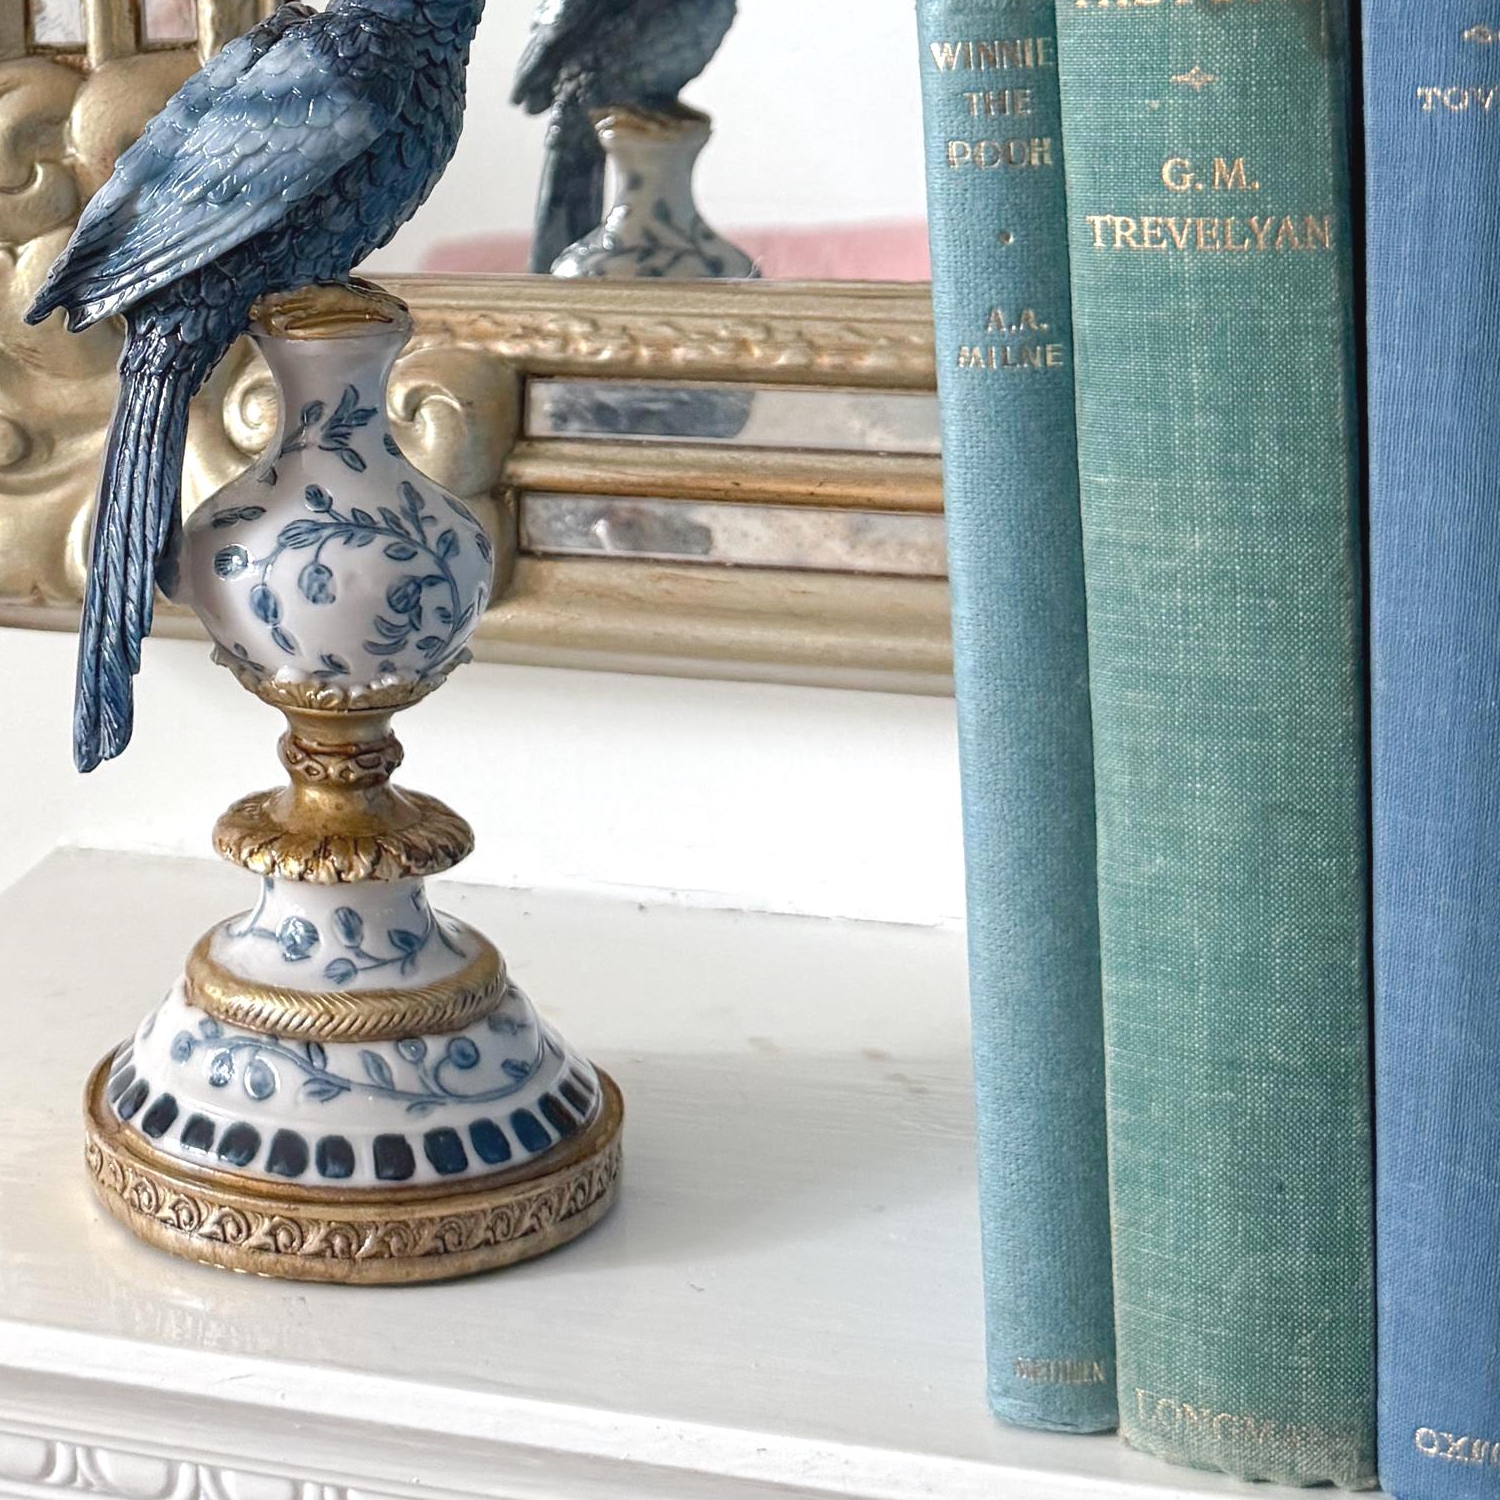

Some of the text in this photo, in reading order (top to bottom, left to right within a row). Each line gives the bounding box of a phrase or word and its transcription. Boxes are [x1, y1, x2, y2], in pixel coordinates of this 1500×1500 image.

[930, 37, 1054, 72] WINNIE
[963, 88, 1033, 117] THE
[947, 138, 1053, 169] POOH
[1087, 213, 1333, 251] TREVELYAN
[986, 308, 1050, 334] A.A.
[957, 344, 1064, 370] MILNE
[1135, 1387, 1346, 1445] LONGM
[1414, 1427, 1500, 1464] OXF
